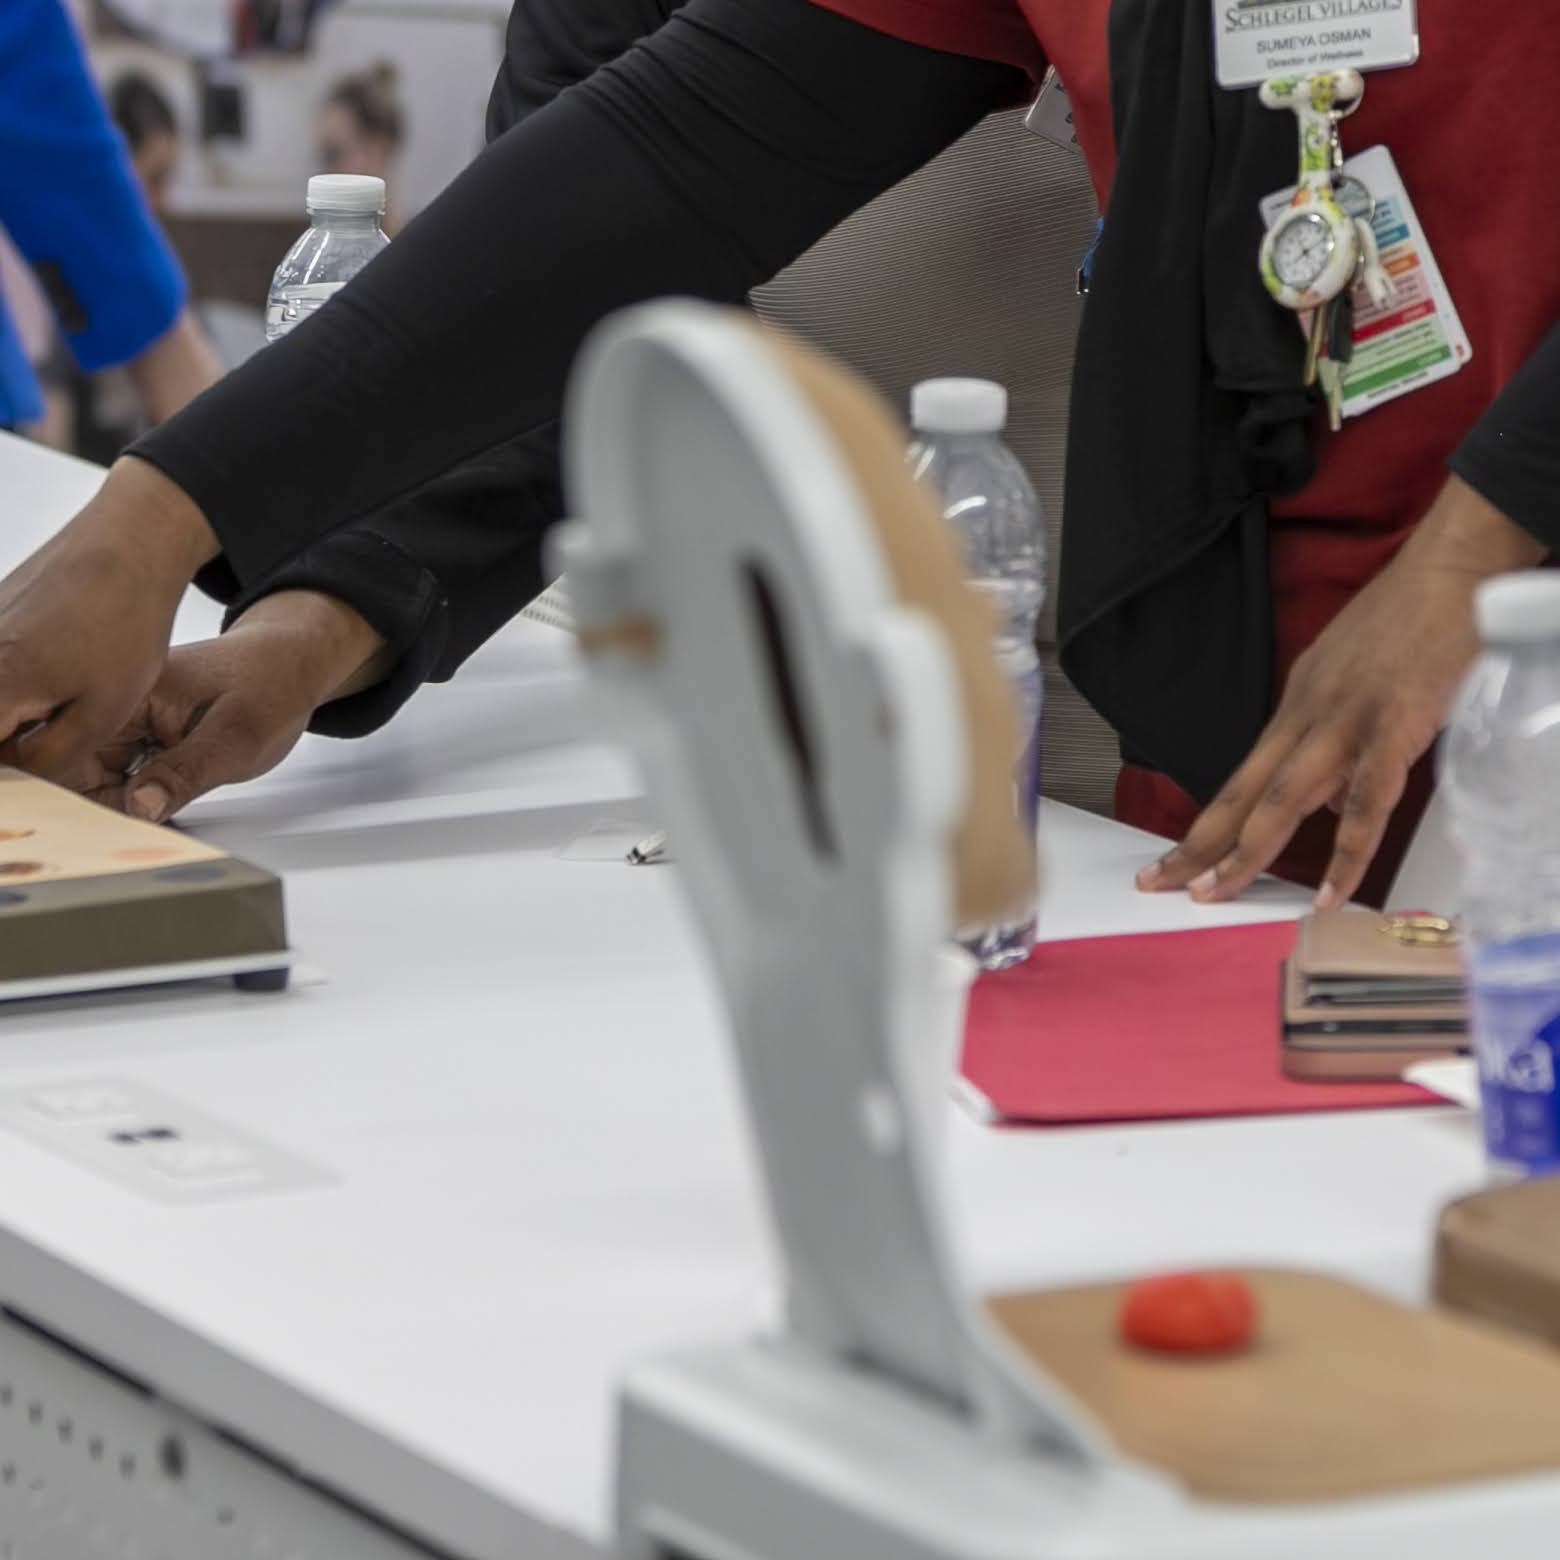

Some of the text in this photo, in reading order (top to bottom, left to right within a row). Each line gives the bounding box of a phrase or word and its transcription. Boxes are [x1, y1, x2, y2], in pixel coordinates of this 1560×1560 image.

[1225, 4, 1314, 34] SCHLEGEL
[1256, 28, 1371, 54] SUMEYA OSMAN
[1308, 54, 1317, 64] of
